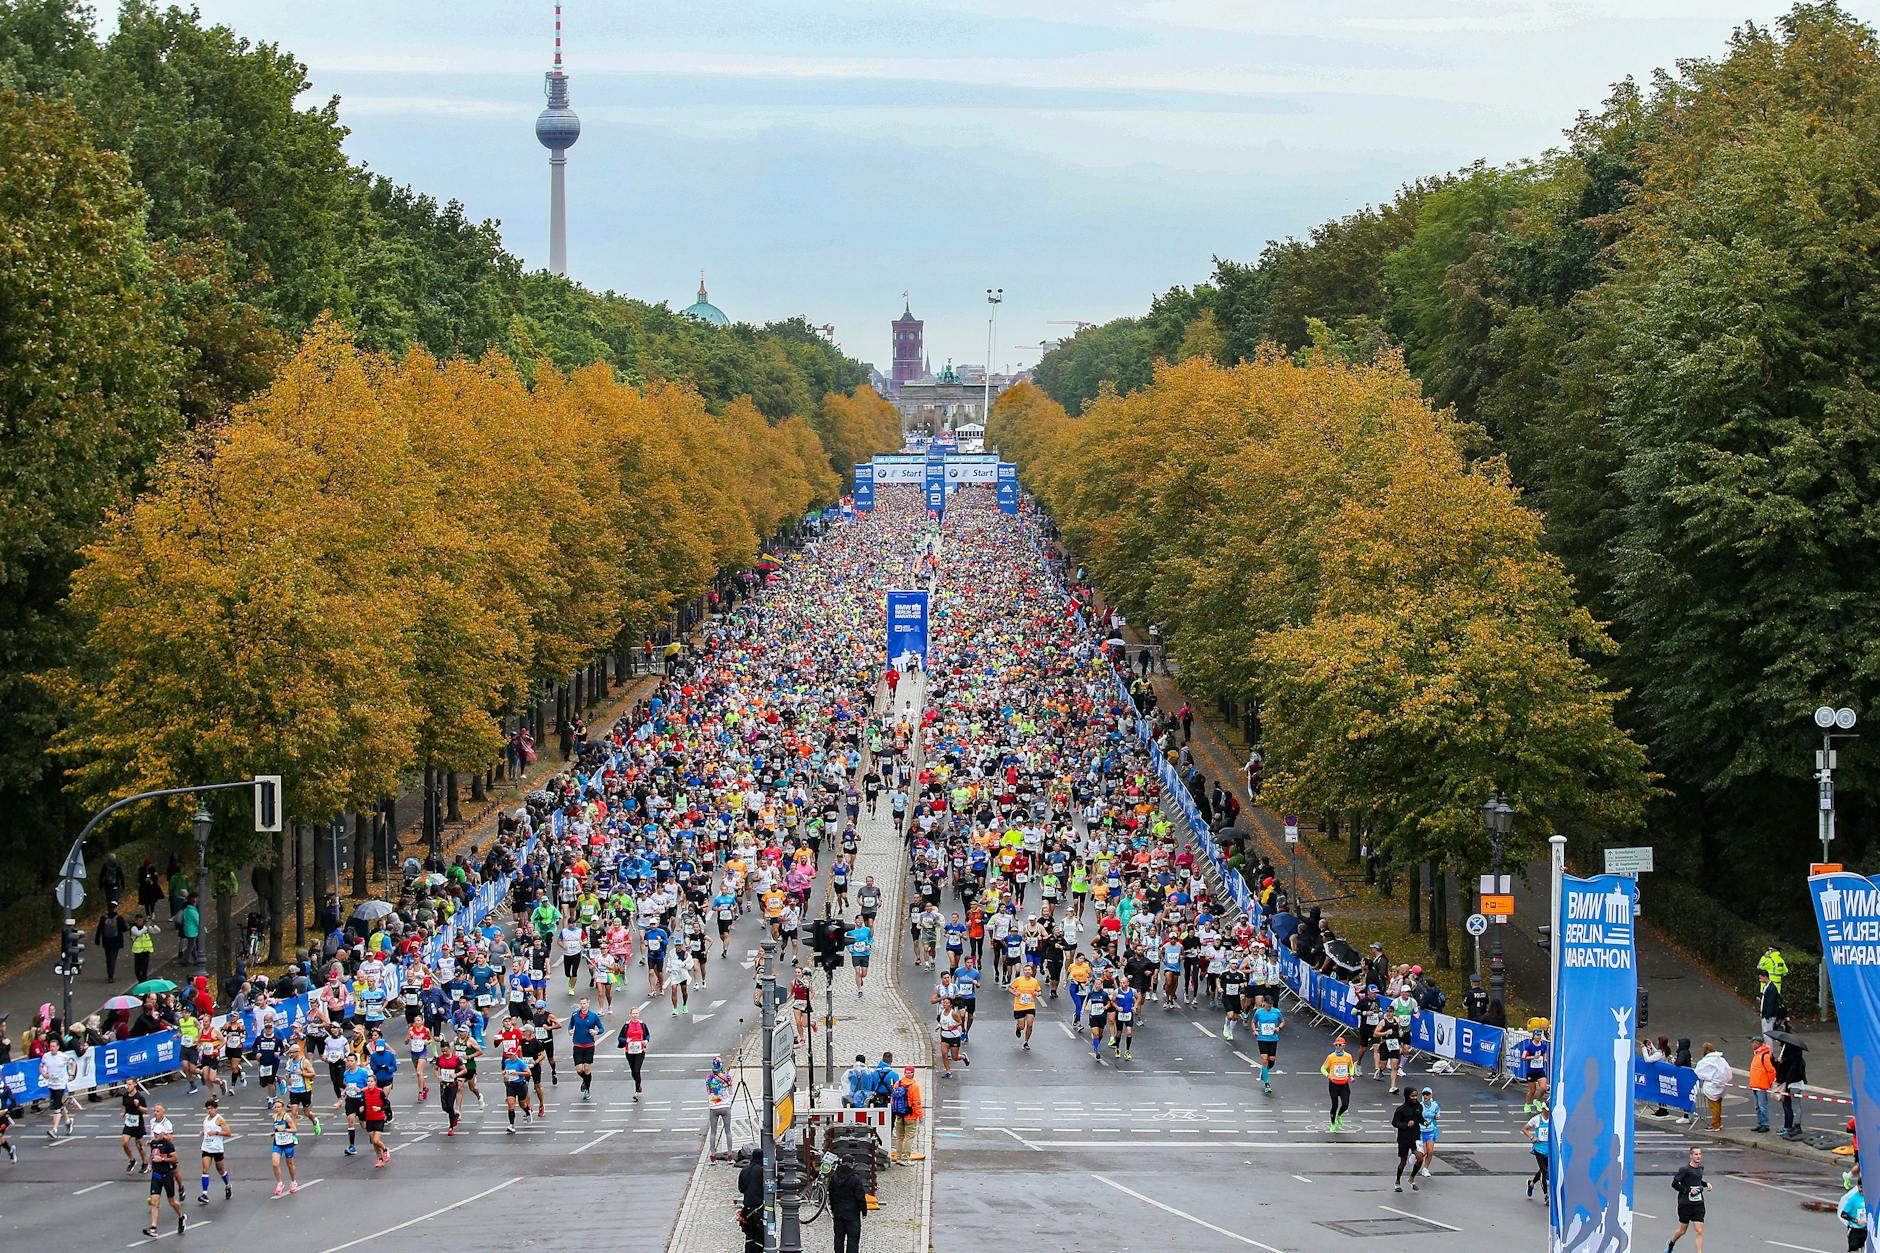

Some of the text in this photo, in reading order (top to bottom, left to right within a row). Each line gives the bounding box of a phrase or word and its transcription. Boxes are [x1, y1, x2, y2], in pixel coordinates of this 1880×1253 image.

[901, 469, 922, 477] Start
[973, 469, 993, 477] Start
[1568, 891, 1604, 920] BMW
[1565, 923, 1603, 944] BERLIN
[1564, 947, 1631, 969] MARATHON
